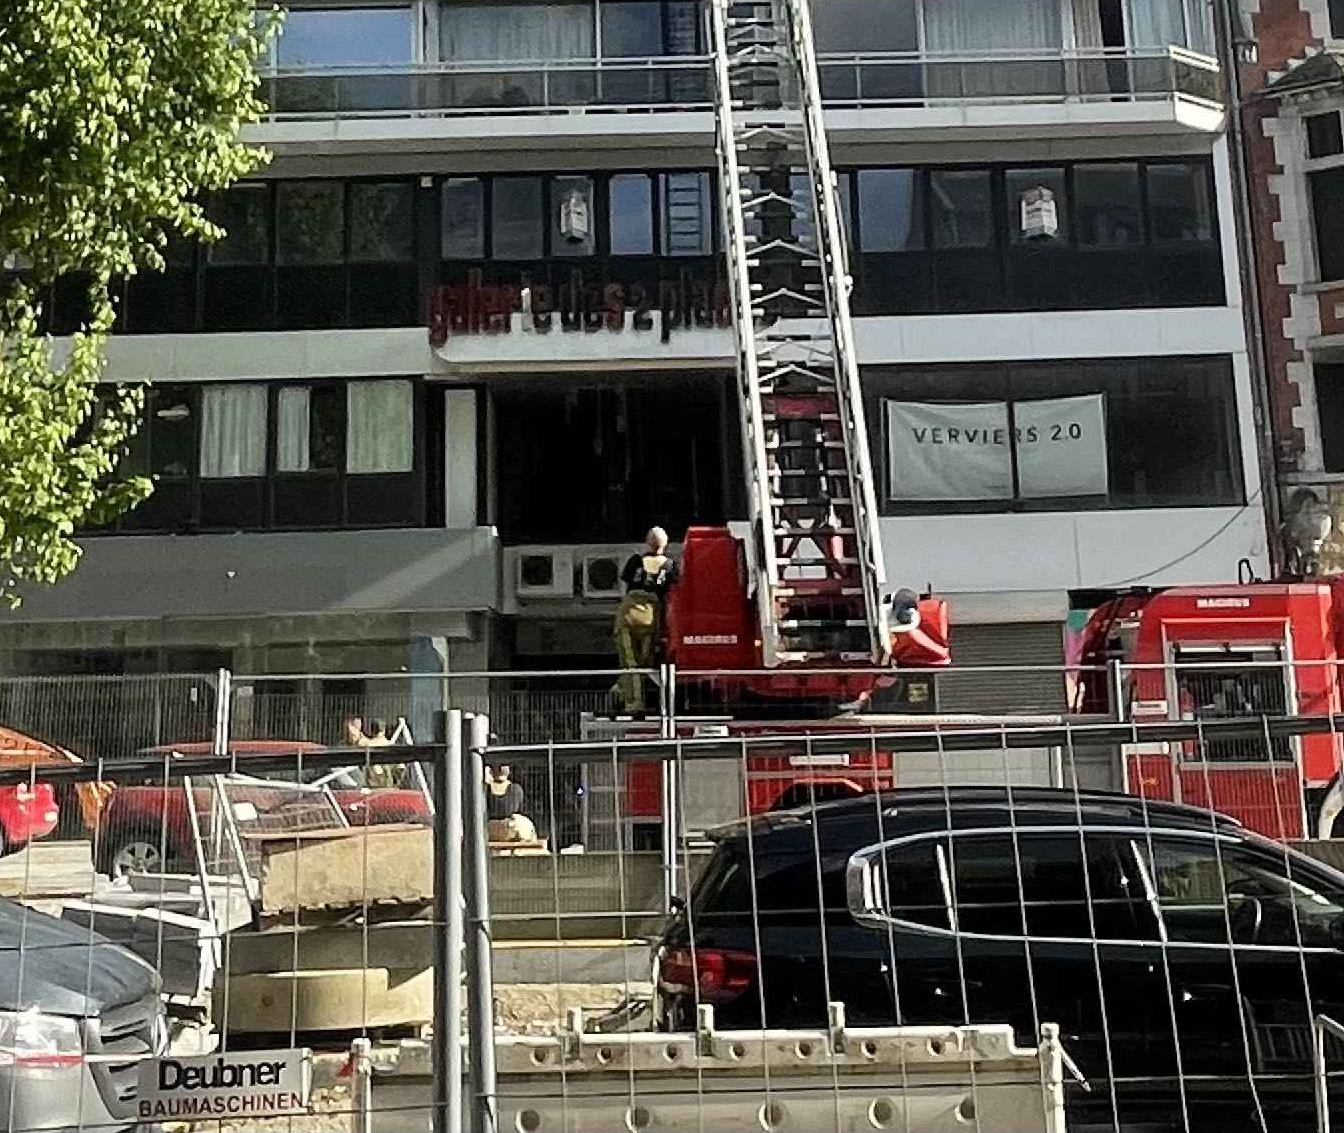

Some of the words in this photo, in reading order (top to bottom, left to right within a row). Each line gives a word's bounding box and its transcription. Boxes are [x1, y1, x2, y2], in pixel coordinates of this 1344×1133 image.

[1050, 422, 1083, 442] 2.0
[159, 1057, 287, 1091] Deubner
[139, 1092, 303, 1117] BAUMASCHINEN
